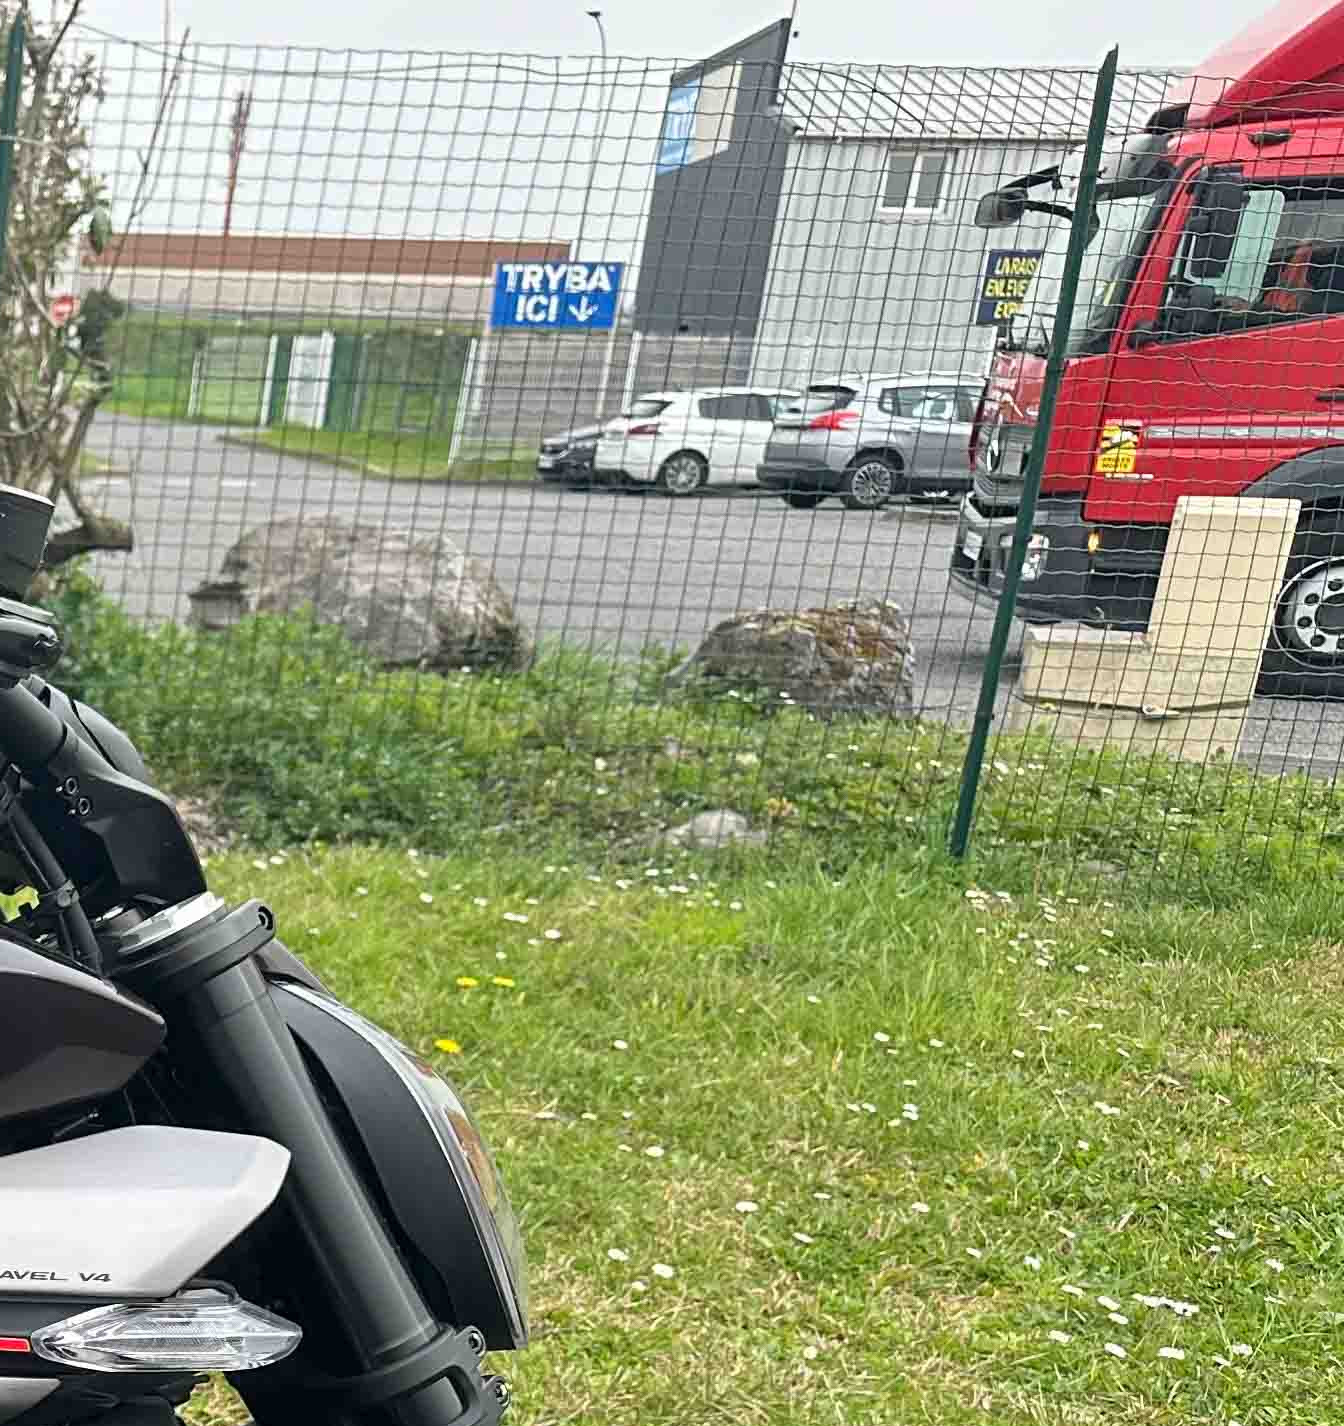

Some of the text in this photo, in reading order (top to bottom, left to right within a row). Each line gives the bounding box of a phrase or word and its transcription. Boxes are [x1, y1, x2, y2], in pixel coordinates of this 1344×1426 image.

[502, 264, 612, 293] TRYBA
[514, 295, 558, 323] ICI
[78, 1271, 113, 1284] V4
